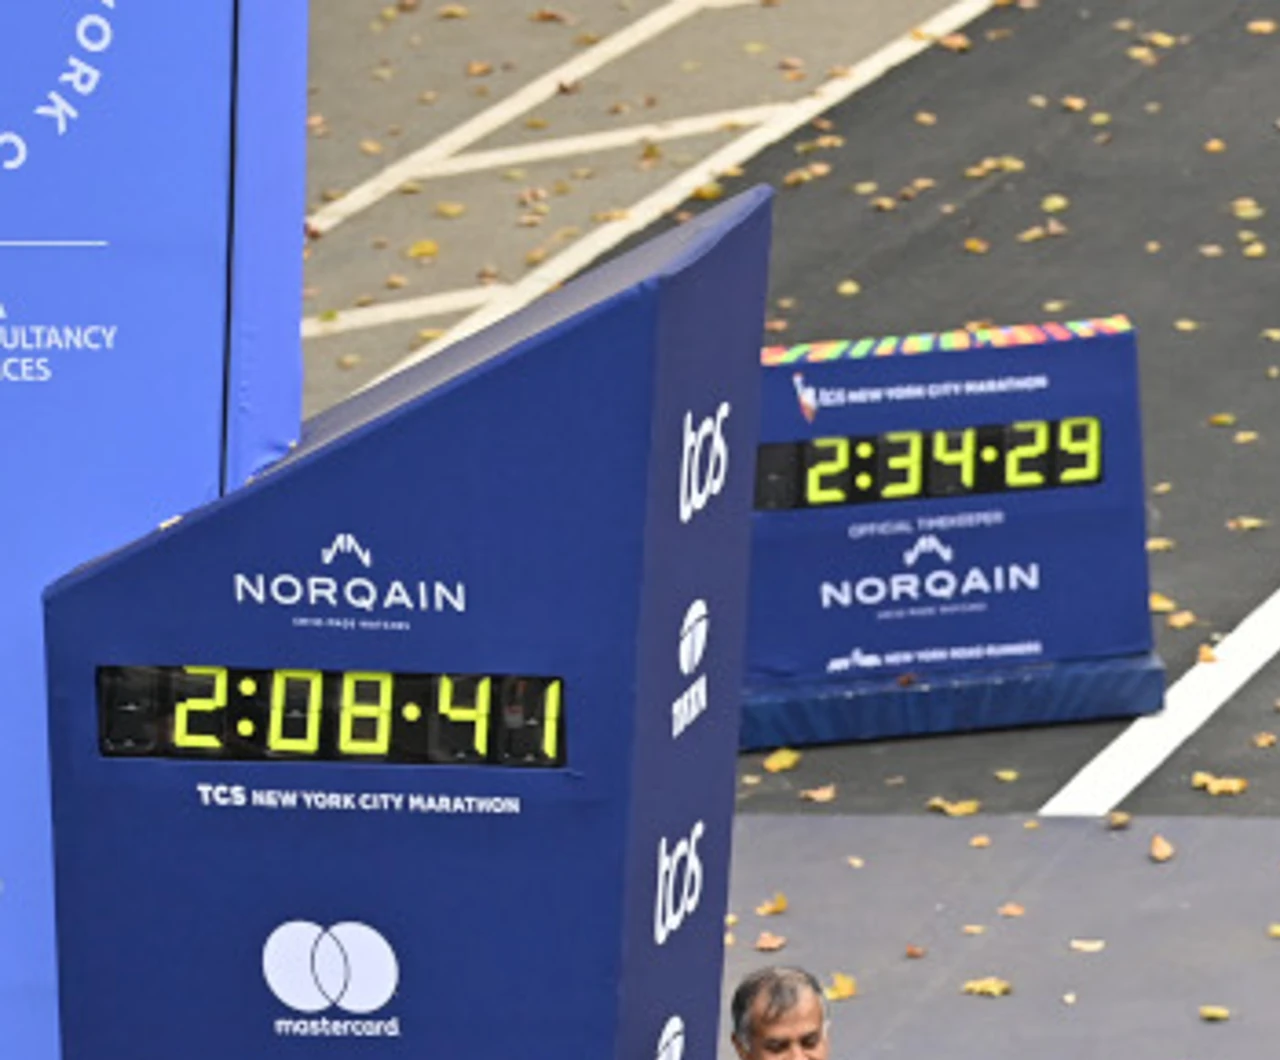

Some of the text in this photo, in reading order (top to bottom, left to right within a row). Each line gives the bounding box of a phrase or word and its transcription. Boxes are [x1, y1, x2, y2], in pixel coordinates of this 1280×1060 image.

[33, 0, 115, 136] ORK
[680, 402, 730, 523] tcs
[848, 520, 913, 539] OFFICIAL
[233, 573, 466, 612] NORQAIN
[820, 563, 1040, 609] NORQAIN
[197, 784, 521, 814] TCS NEW YORK CITY MARATHON
[655, 820, 705, 945] tcs
[275, 1017, 400, 1036] mastercard
